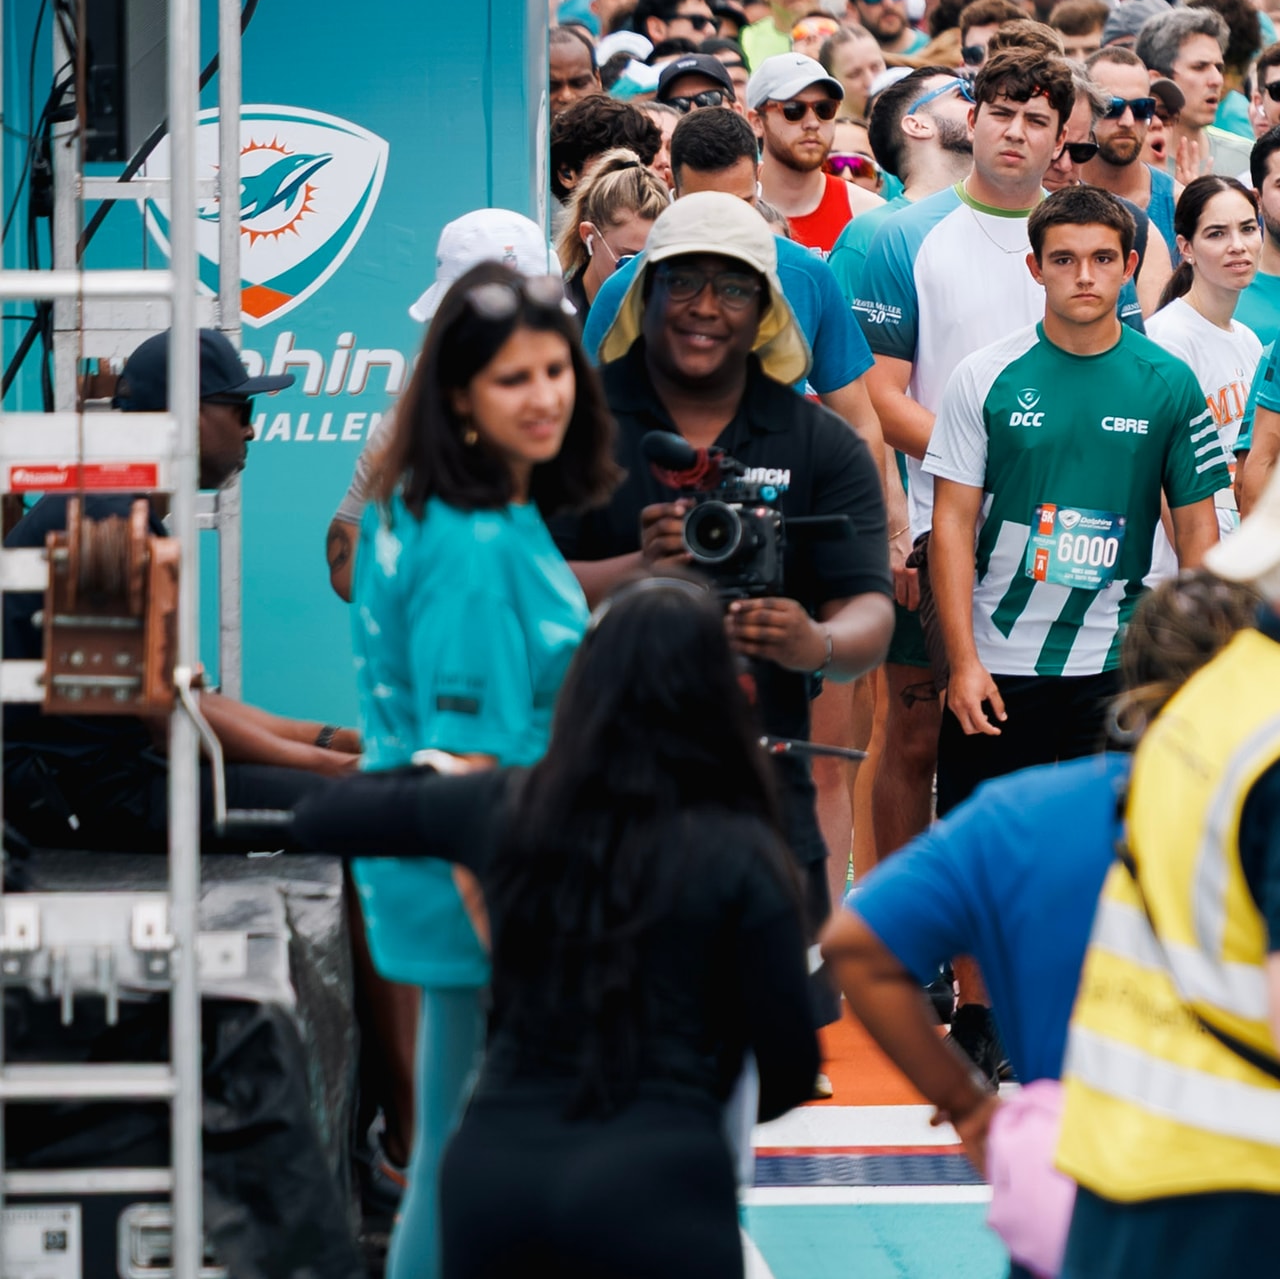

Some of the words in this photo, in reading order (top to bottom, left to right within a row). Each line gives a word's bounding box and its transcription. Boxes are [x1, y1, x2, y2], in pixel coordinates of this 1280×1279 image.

[1009, 411, 1045, 427] DCC
[1101, 416, 1149, 434] CBRE
[1042, 510, 1055, 523] 5K
[1057, 532, 1119, 568] 6000
[1037, 559, 1044, 571] A
